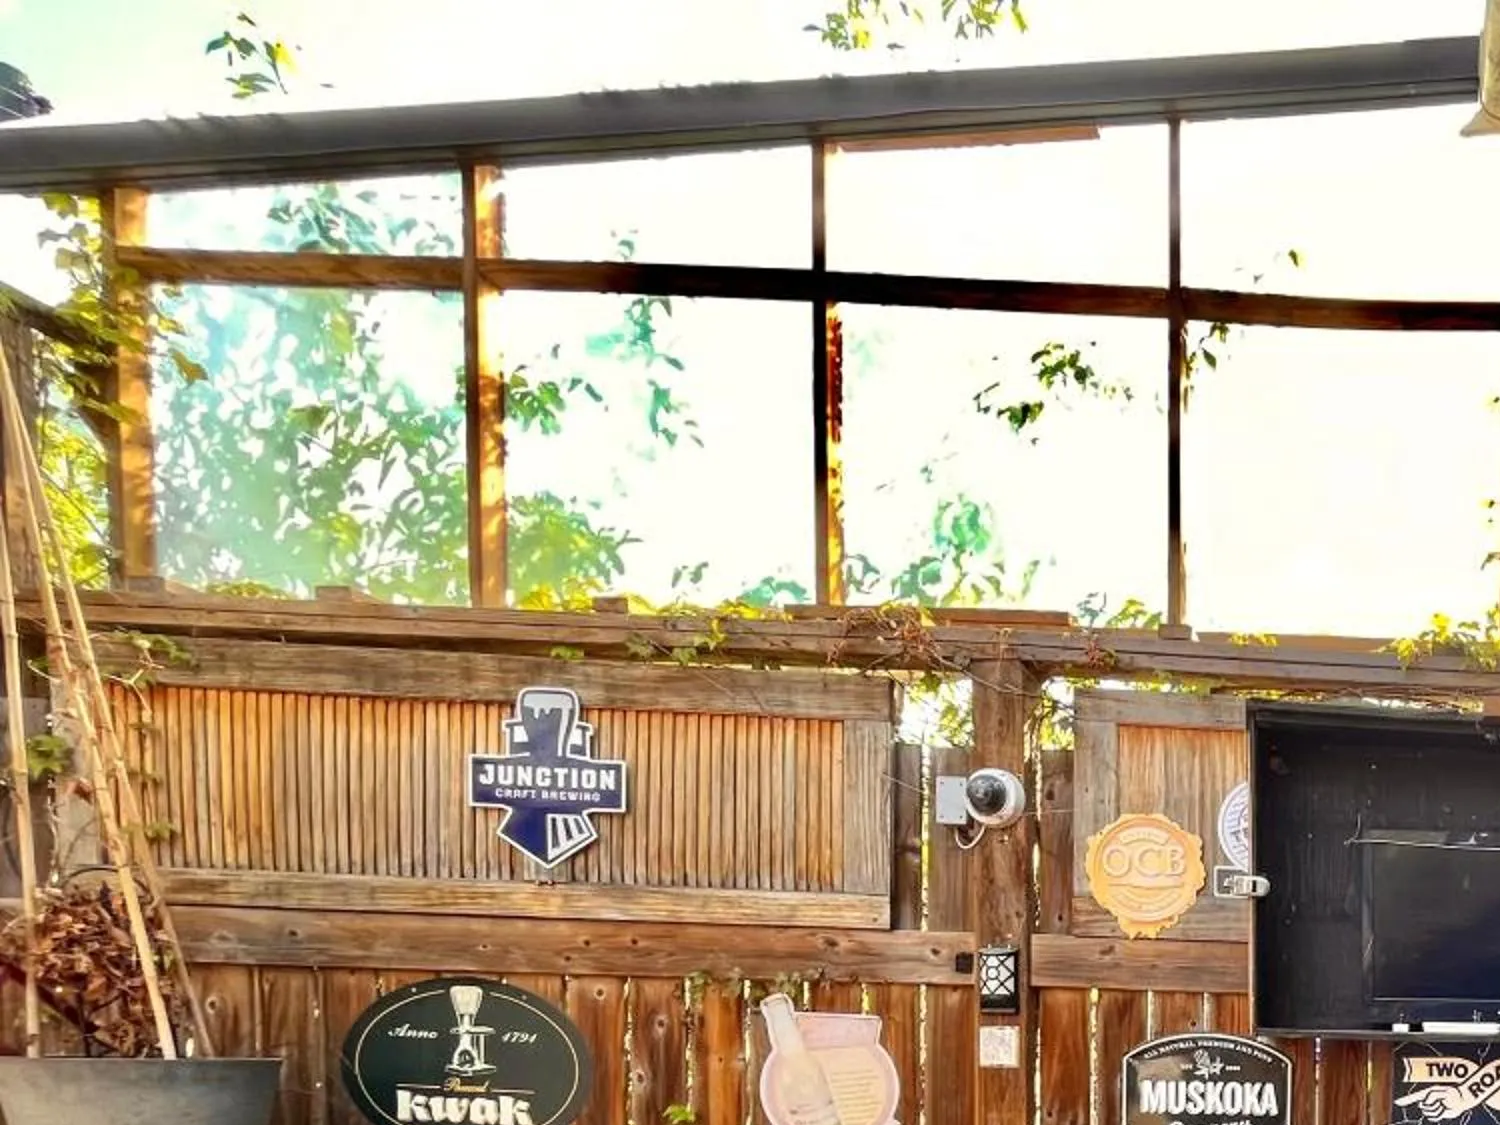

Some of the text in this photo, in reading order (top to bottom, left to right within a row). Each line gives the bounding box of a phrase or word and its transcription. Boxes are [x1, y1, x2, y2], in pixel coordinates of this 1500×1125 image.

[479, 763, 616, 791] JUNCTION
[495, 788, 601, 803] CRAFT BREWING
[1103, 844, 1185, 878] OCB
[1426, 1062, 1469, 1079] TWO
[1139, 1080, 1279, 1116] MUSKOKA
